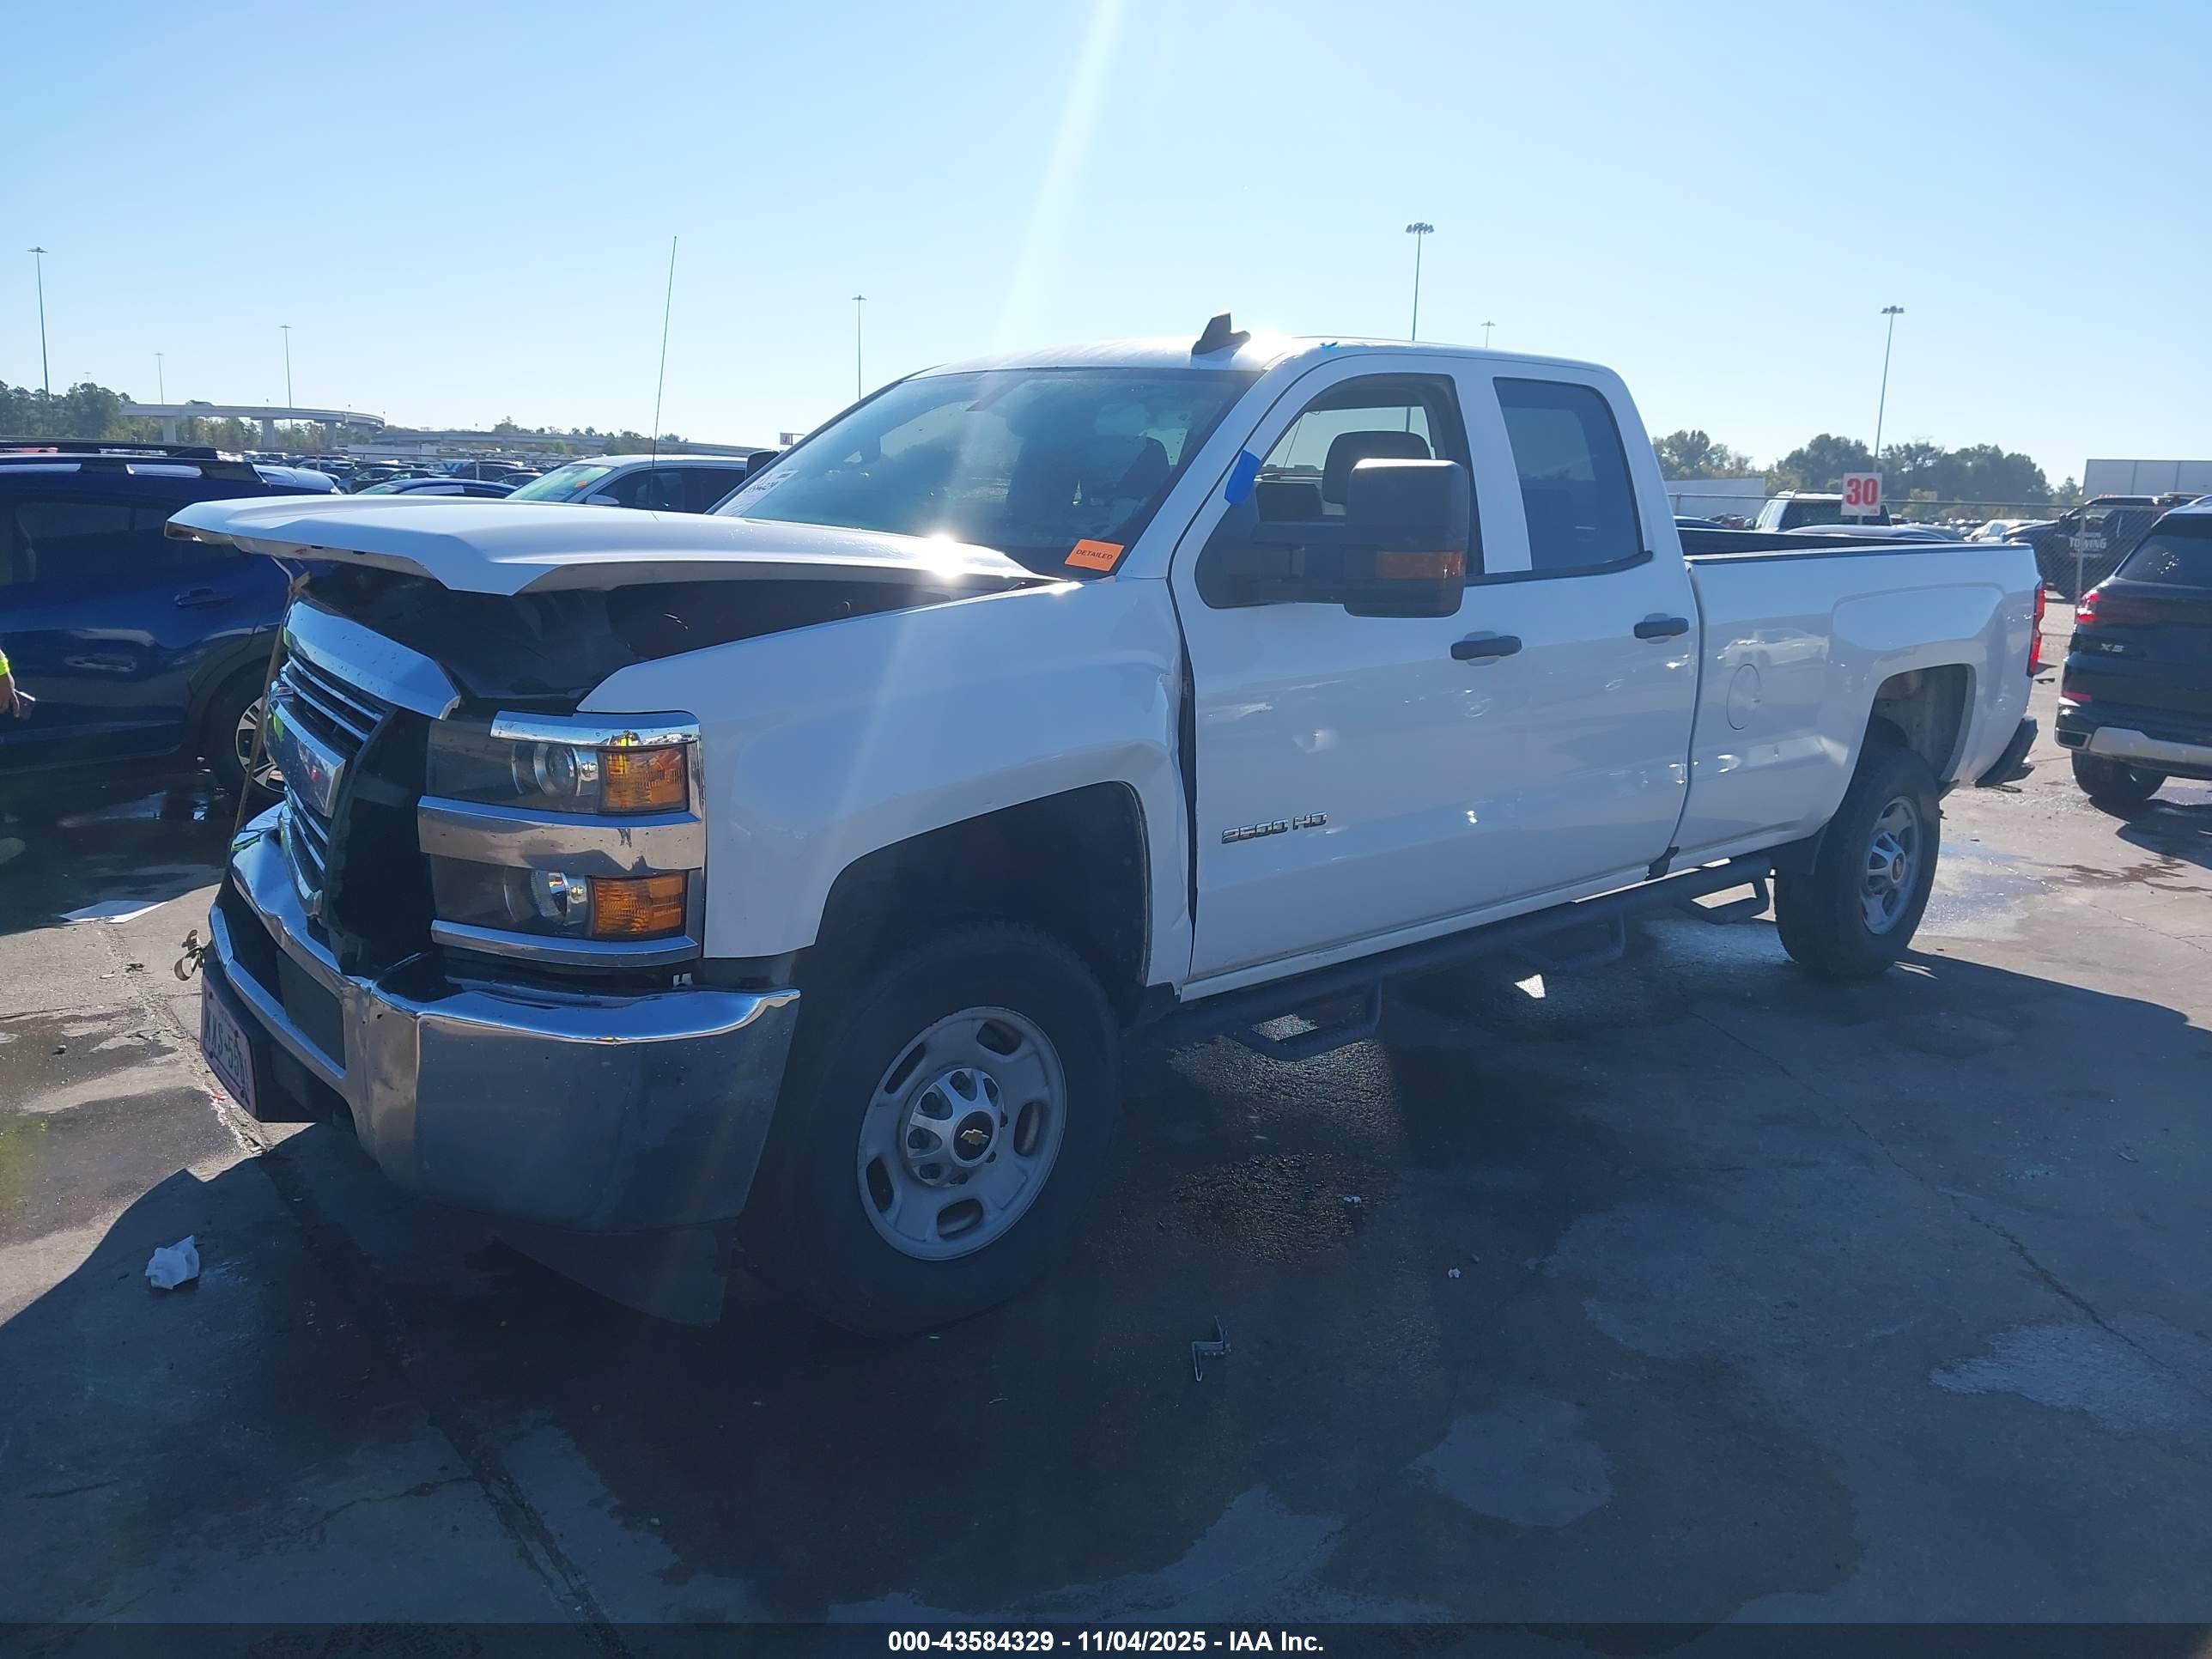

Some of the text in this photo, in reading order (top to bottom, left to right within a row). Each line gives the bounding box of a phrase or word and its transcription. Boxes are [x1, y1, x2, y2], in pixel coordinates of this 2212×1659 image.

[1846, 477, 1878, 507] 30
[1075, 549, 1114, 560] DETAILED
[1222, 811, 1328, 844] 2500 HD
